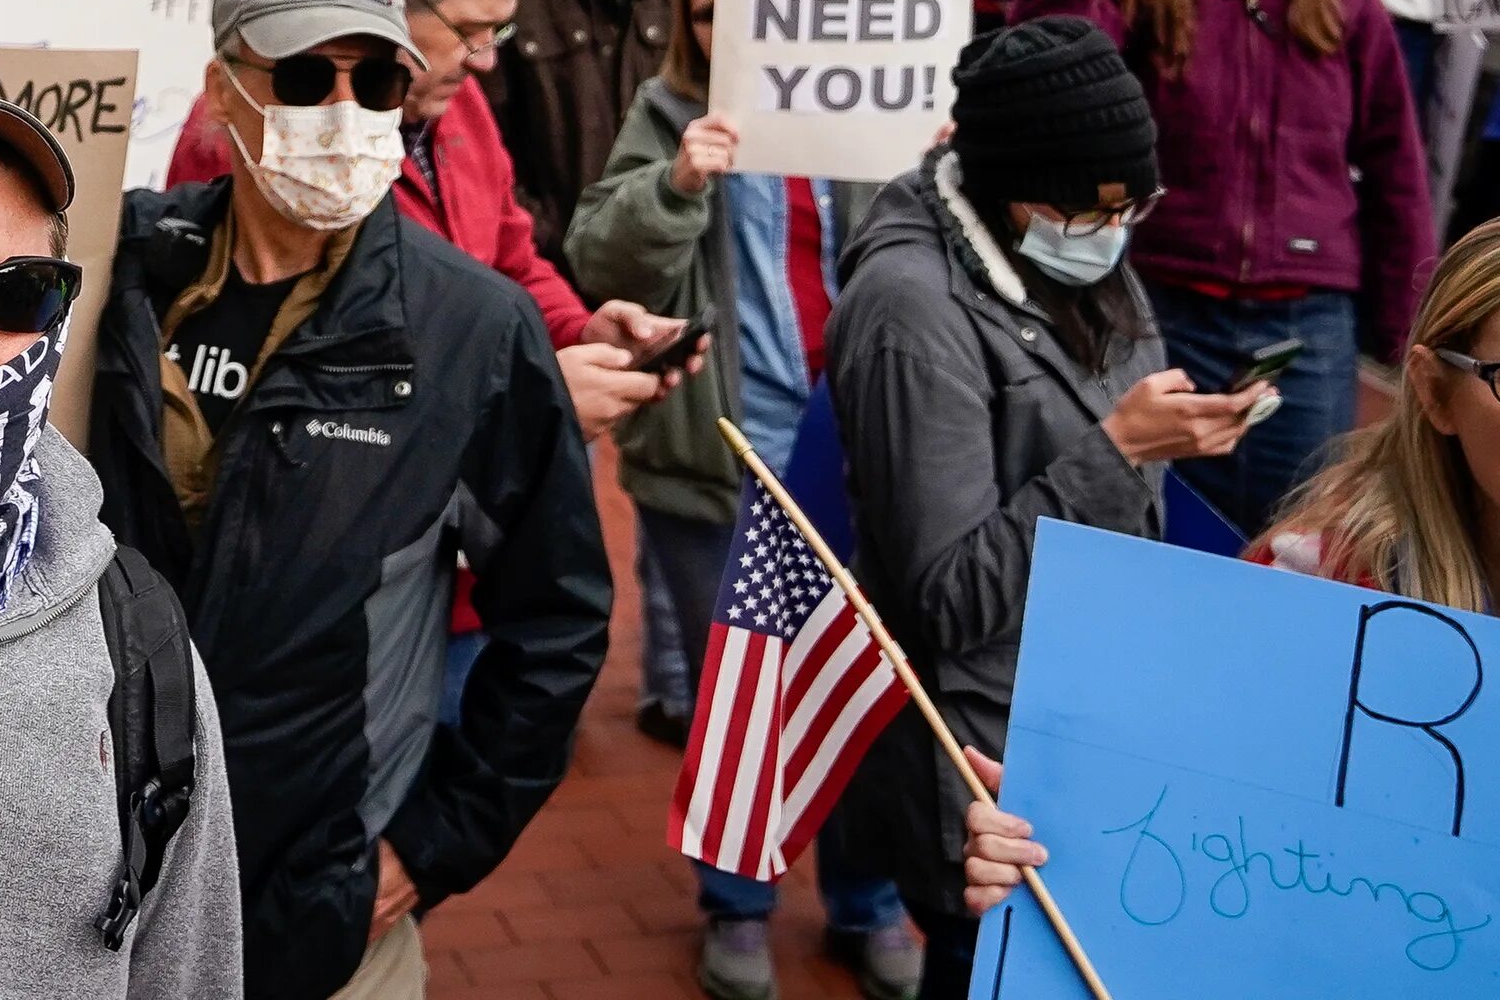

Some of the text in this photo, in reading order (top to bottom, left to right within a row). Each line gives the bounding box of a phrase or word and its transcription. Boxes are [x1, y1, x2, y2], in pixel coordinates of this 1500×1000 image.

[762, 64, 937, 112] YOU!
[321, 420, 392, 447] Columbia
[1102, 783, 1492, 971] fighting
